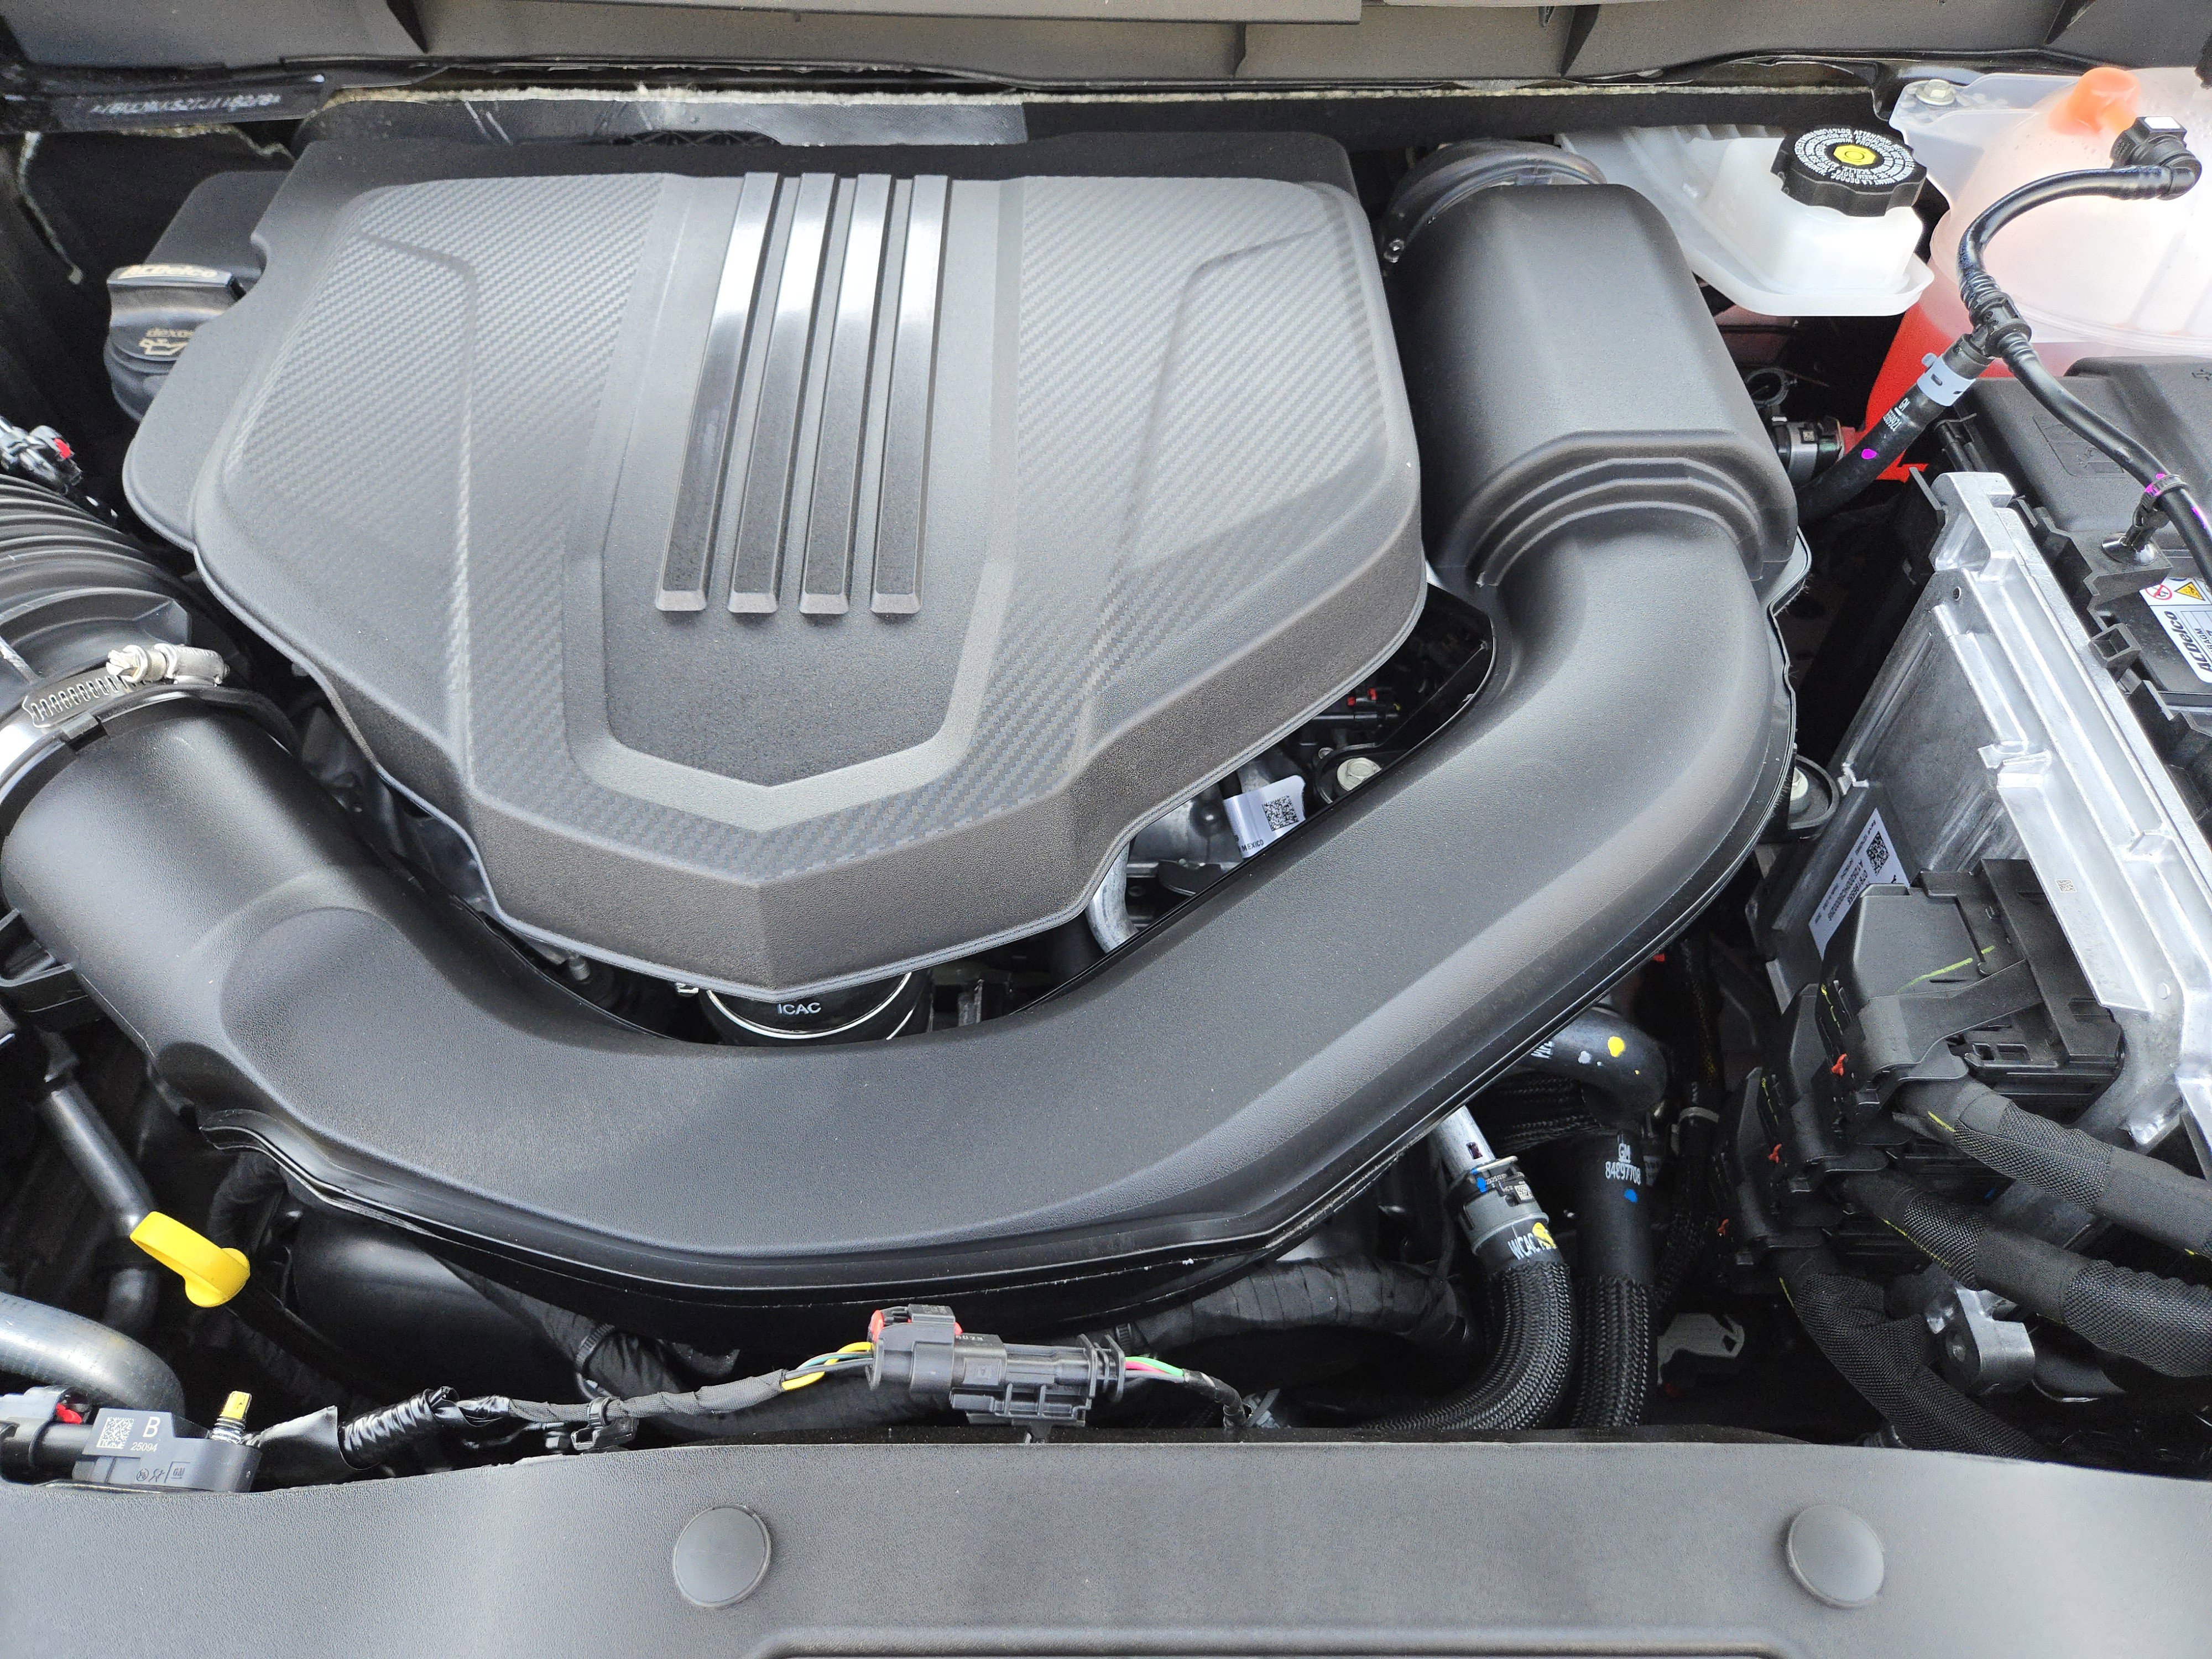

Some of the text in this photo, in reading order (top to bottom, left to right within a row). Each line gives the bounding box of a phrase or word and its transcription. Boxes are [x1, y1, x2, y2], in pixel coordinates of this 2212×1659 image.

[1898, 398, 1910, 411] GM
[2164, 611, 2212, 672] ACDelco
[1241, 839, 1264, 852] MEXICO
[1618, 1143, 1631, 1161] GM
[143, 1416, 160, 1437] B
[130, 1442, 158, 1452] 25094
